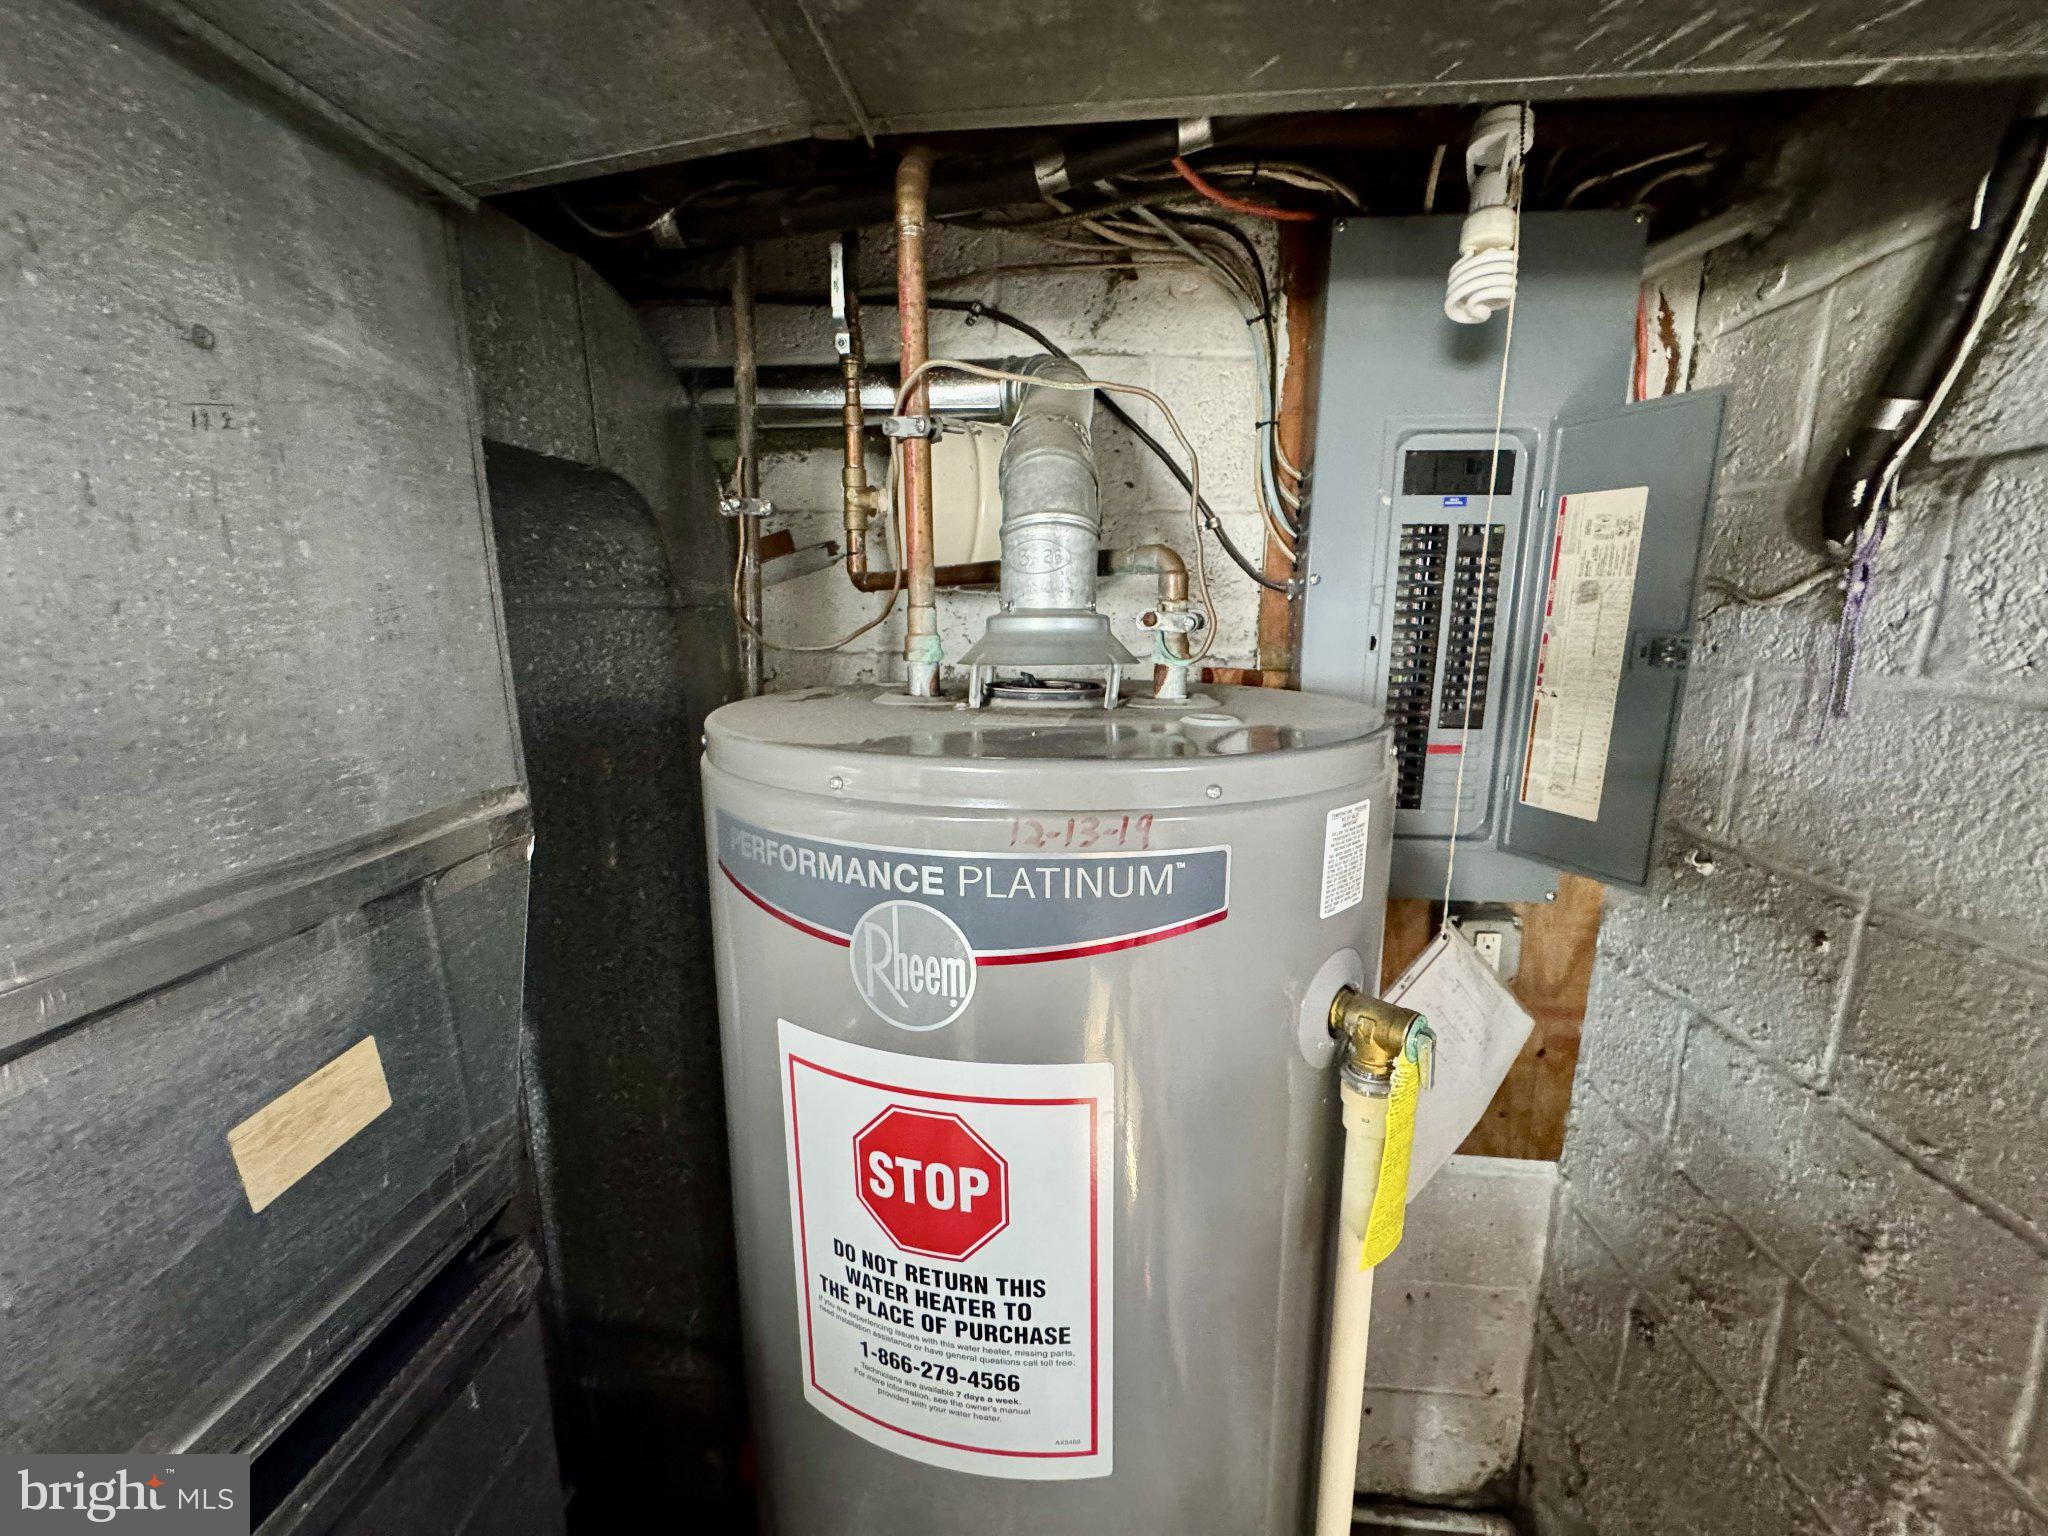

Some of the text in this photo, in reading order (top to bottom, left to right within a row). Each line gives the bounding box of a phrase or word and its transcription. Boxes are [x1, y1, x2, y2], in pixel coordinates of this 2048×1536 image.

[1010, 813, 1154, 850] 12-13-19
[730, 827, 945, 897] PERFORMANCE
[868, 1150, 990, 1213] STOP
[834, 1237, 1046, 1298] DO NOT RETURN THIS
[845, 1265, 1032, 1322] WATER HEATER TO
[819, 1273, 1071, 1345] THE PLACE OF PURCHASE
[848, 1310, 893, 1336] experiencing
[860, 1341, 1020, 1392] 1-866-279-4566
[918, 1383, 954, 1397] available
[956, 1390, 961, 1398] 7
[963, 1392, 985, 1403] days
